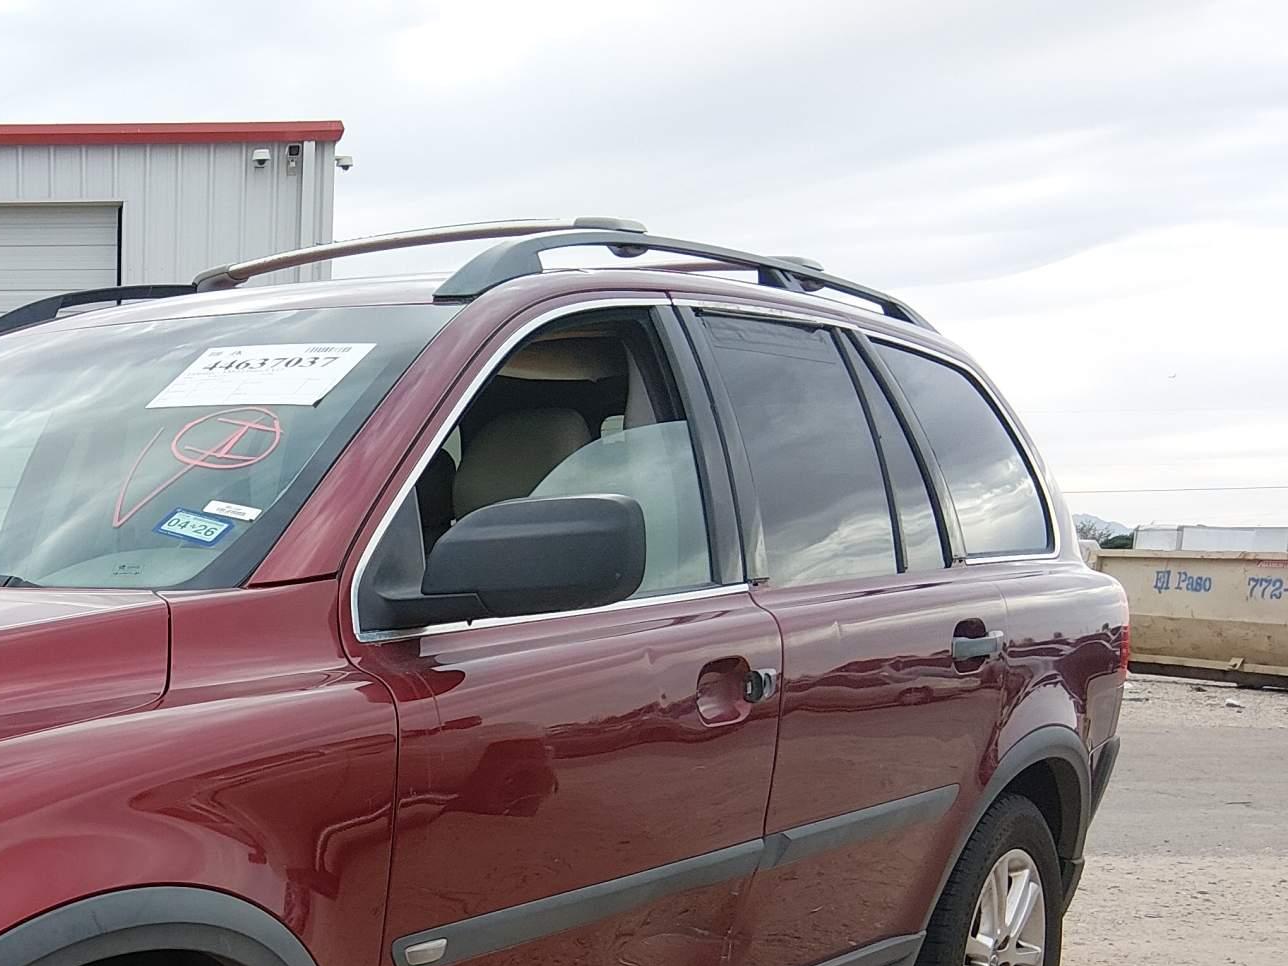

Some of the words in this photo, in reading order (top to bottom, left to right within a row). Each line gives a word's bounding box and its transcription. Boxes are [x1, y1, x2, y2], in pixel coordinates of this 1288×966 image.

[203, 356, 338, 372] 44637037
[1153, 570, 1171, 594] El
[1175, 571, 1212, 593] Paso
